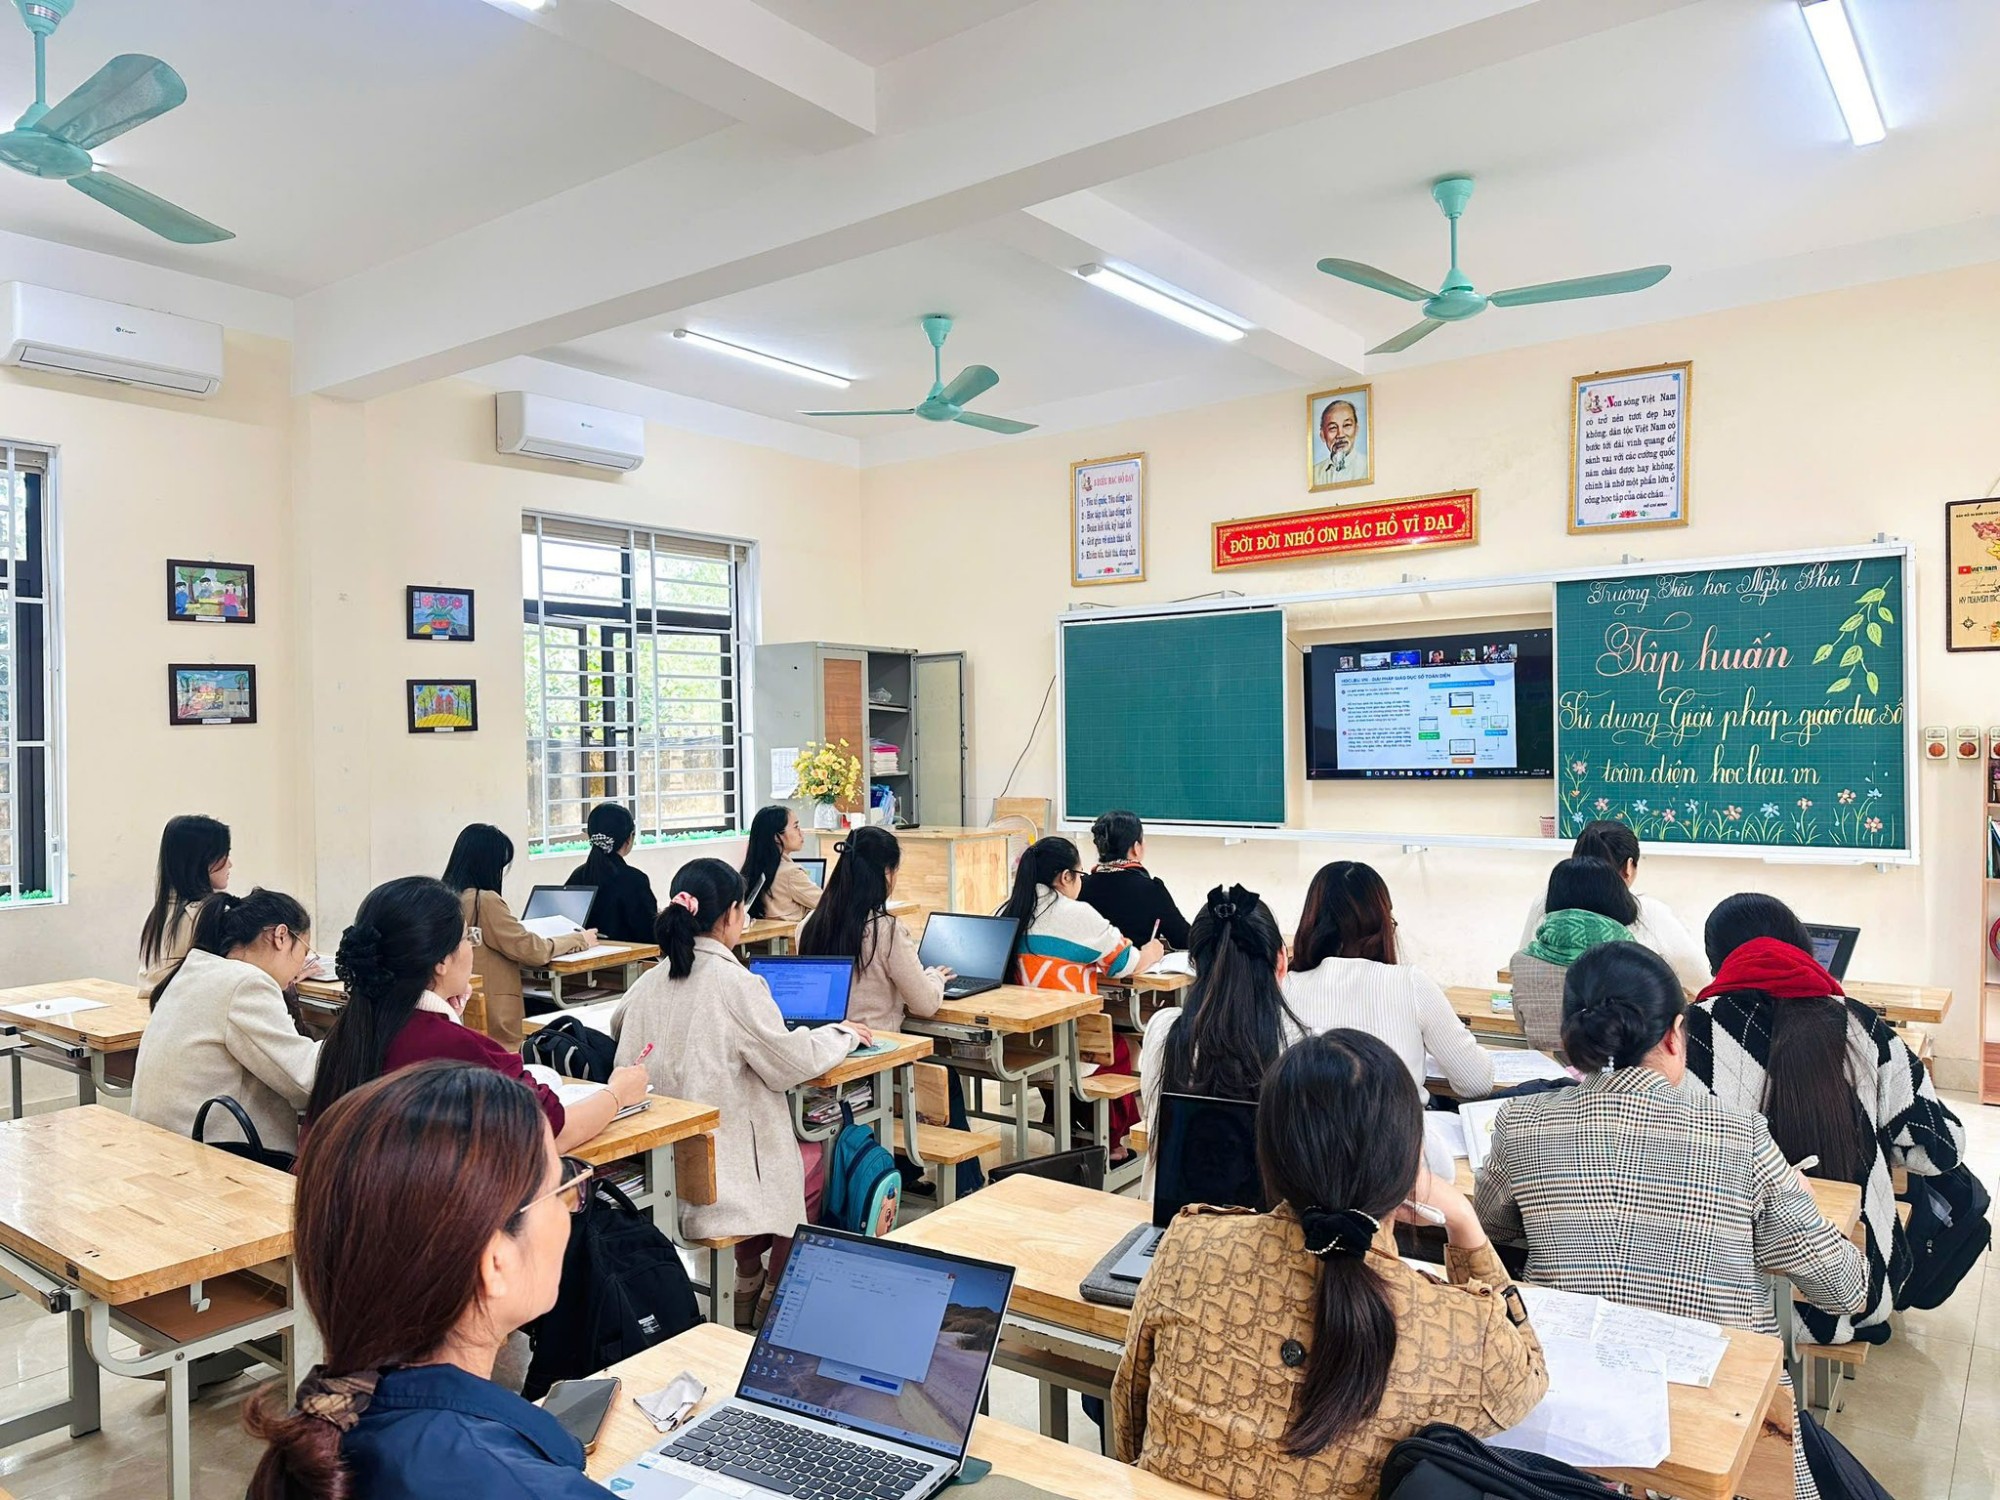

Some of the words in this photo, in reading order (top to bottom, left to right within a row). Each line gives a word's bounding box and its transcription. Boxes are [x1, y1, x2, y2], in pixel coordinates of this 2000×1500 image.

[1660, 393, 1676, 401] Nam
[1663, 409, 1676, 417] hay
[1650, 423, 1666, 431] Nam
[1659, 446, 1675, 459] quốc
[1637, 464, 1649, 473] hay
[1229, 532, 1254, 554] ĐỜI
[1256, 529, 1280, 551] ĐỜI
[1284, 526, 1314, 548] NHỚ
[1317, 524, 1338, 543] ƠN
[1344, 519, 1372, 539] BÁC
[1376, 512, 1398, 536] HỒ
[1401, 514, 1420, 533] VĨ
[1423, 513, 1454, 534] ĐẠI
[1698, 571, 1732, 597] học
[1846, 560, 1863, 586] 1
[1595, 611, 1692, 691] Tập
[1690, 624, 1794, 671] huấn
[1717, 685, 1792, 740] pháp
[1780, 700, 1845, 747] giáo
[1845, 694, 1879, 728] dục
[1597, 759, 1647, 784] toàn
[1647, 754, 1698, 789] diện
